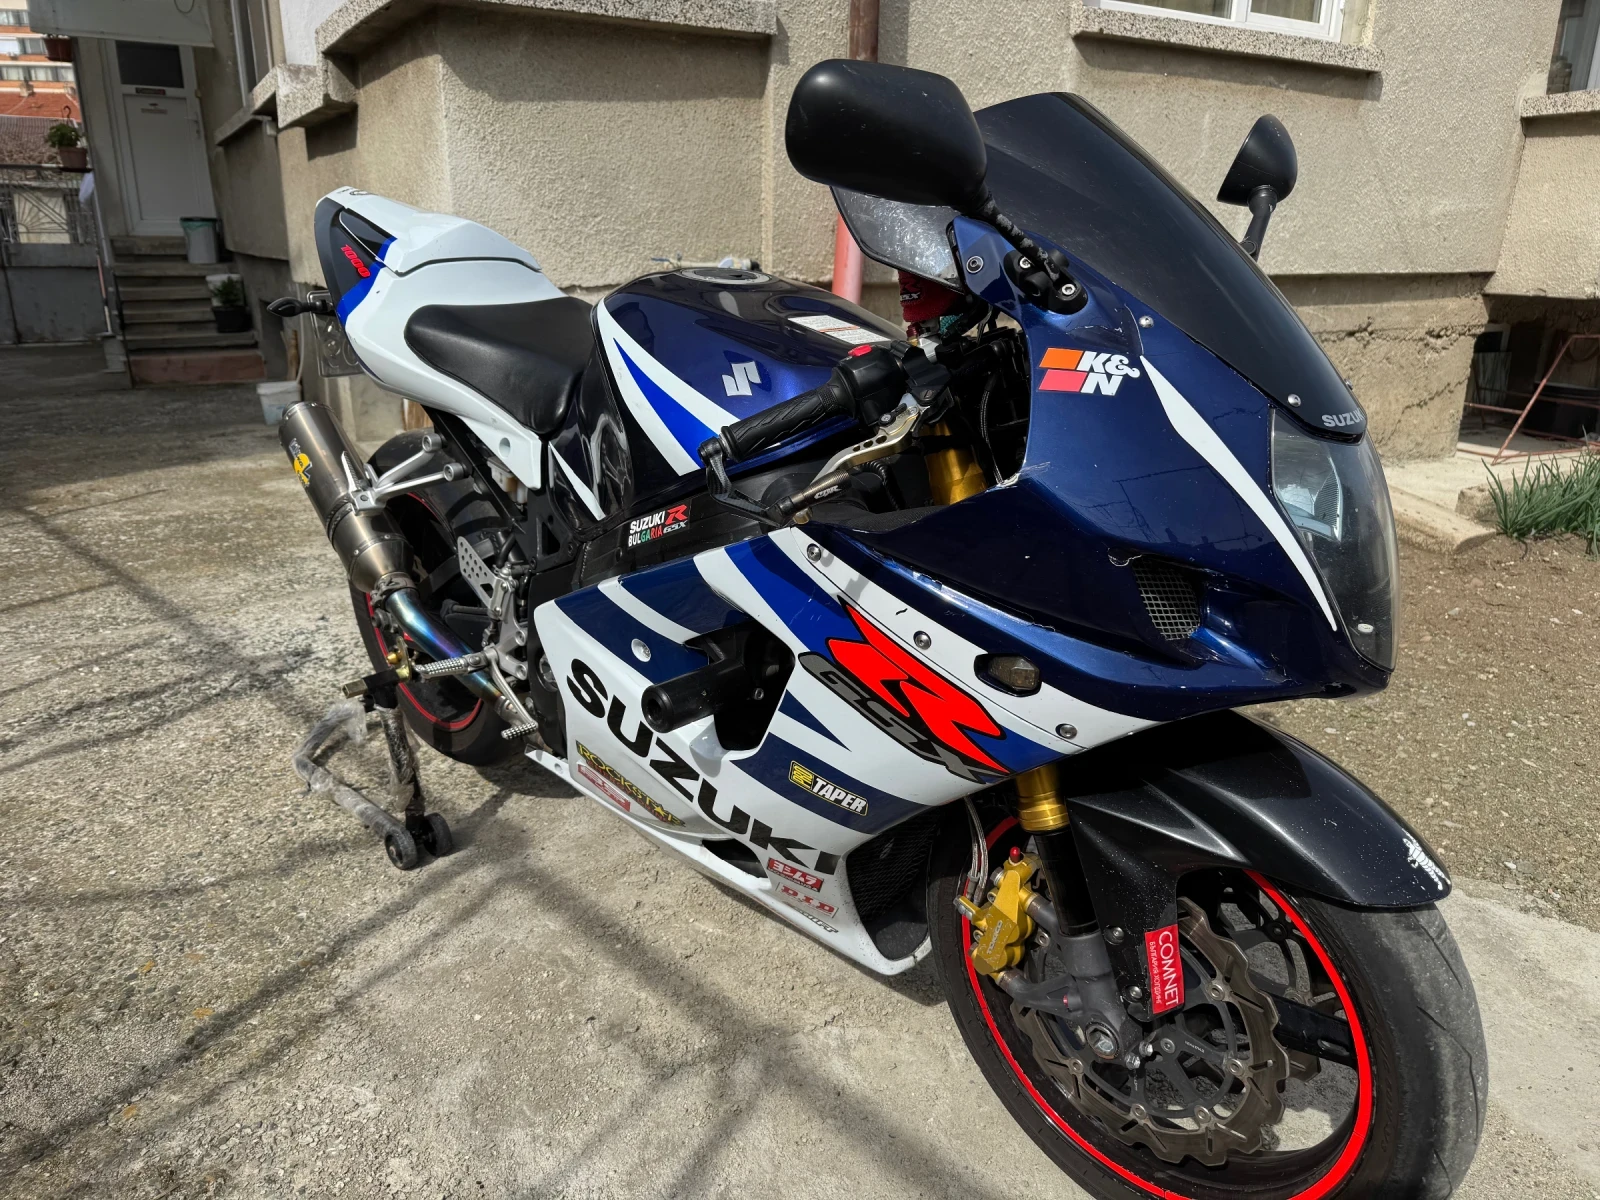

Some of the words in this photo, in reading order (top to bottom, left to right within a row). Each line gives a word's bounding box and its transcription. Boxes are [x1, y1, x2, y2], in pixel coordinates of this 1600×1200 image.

[341, 244, 371, 278] 1000
[1080, 372, 1123, 396] N
[1321, 407, 1366, 428] SUZUK
[627, 525, 663, 547] BULGARIA
[663, 519, 688, 534] GSX
[629, 510, 666, 534] SUZUKI
[664, 504, 688, 525] R
[798, 652, 1008, 785] GSX
[566, 657, 841, 876] SUZUKI
[812, 777, 867, 813] TAPER
[1158, 930, 1179, 1006] COMNET
